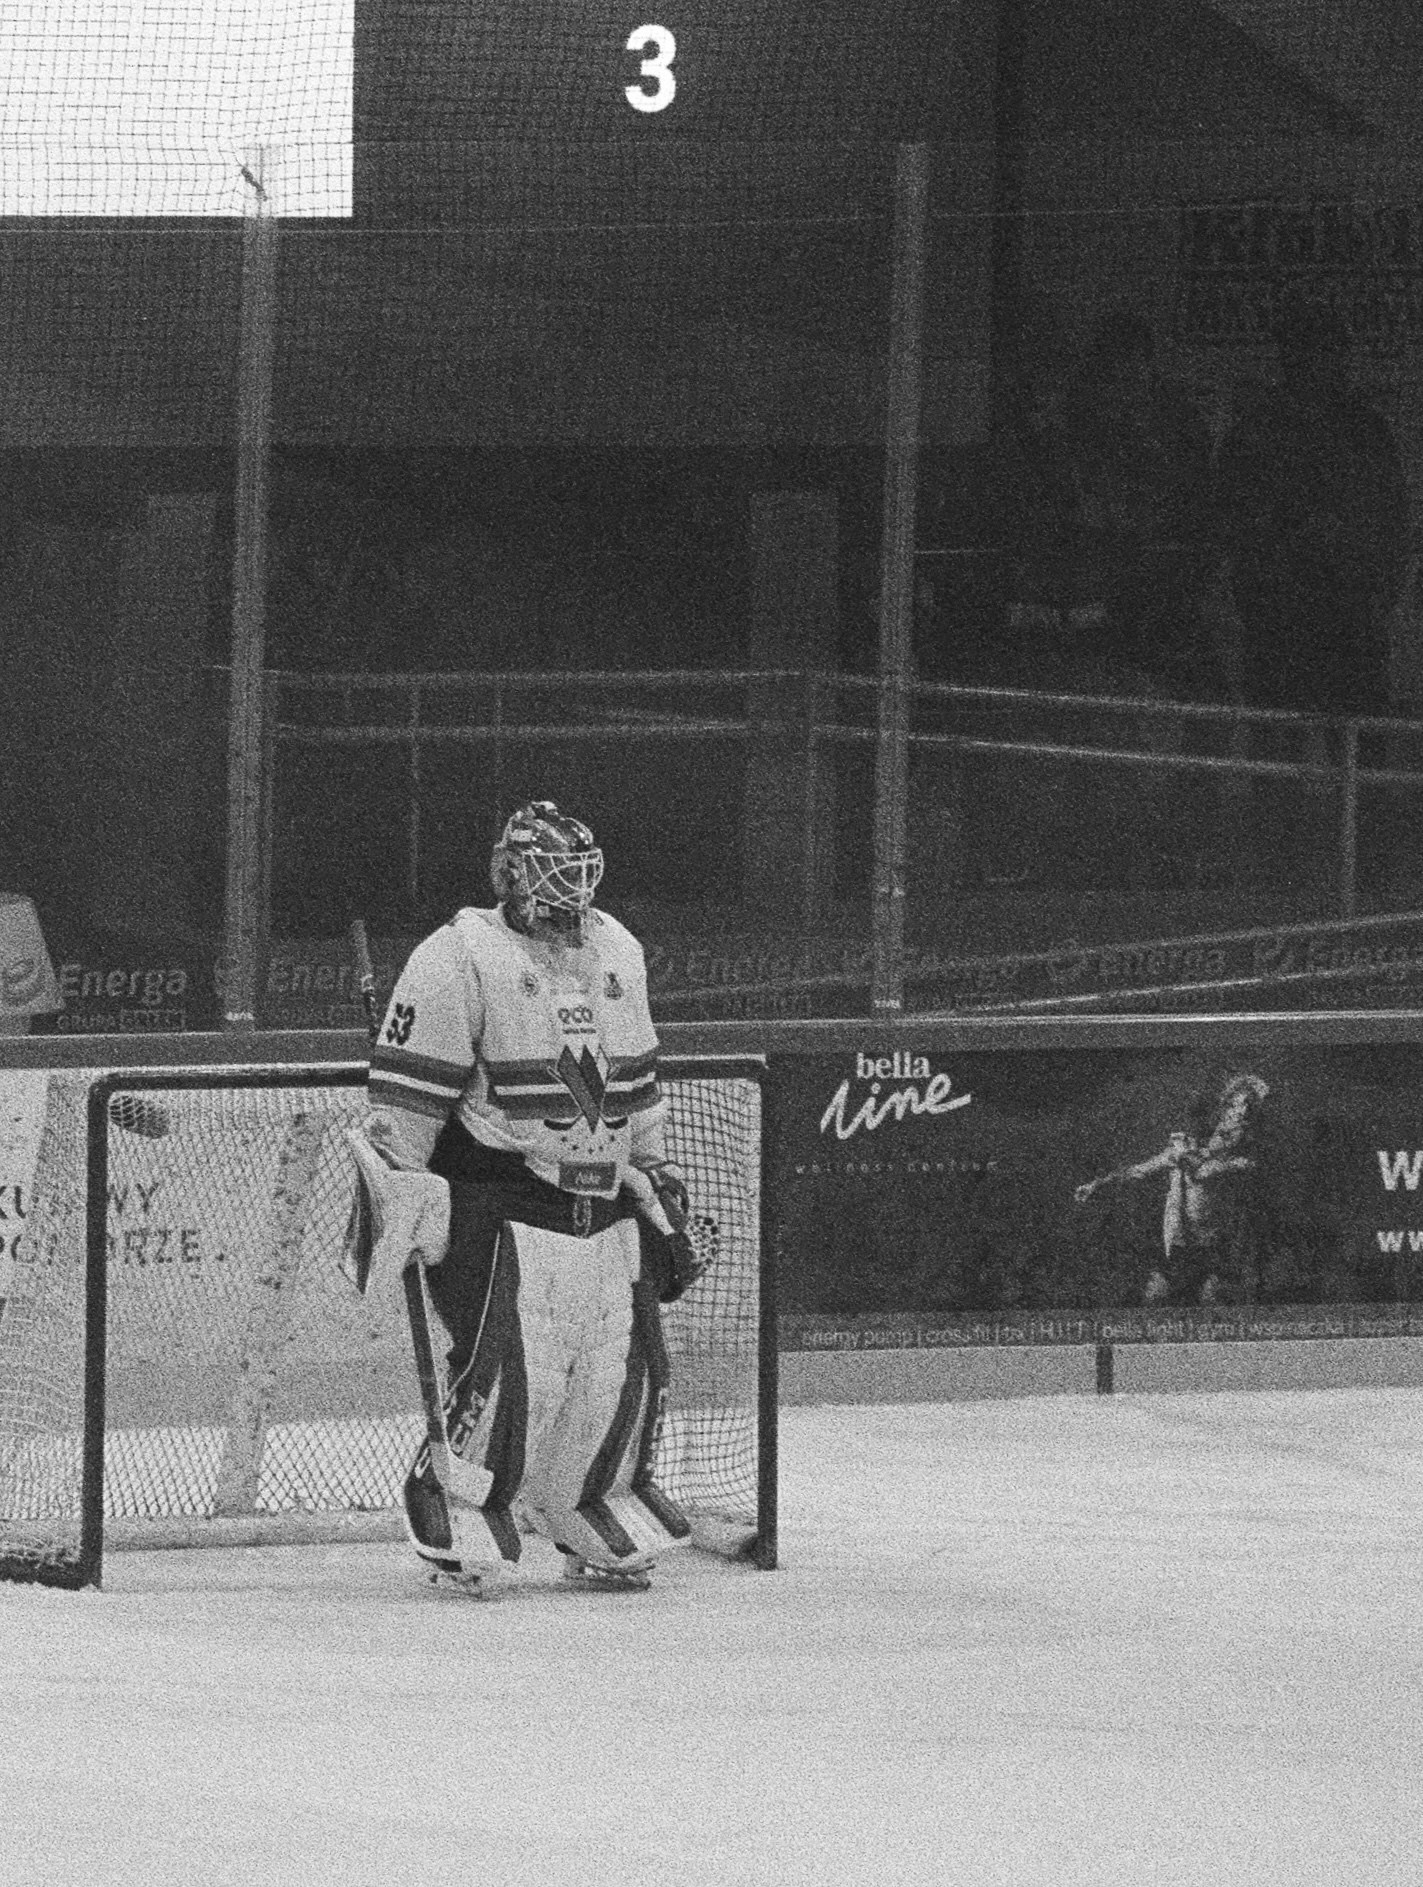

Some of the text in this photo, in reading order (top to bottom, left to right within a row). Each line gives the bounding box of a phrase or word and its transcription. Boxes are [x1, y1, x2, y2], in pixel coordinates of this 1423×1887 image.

[625, 24, 677, 113] 3
[59, 964, 188, 1005] Energa
[856, 1051, 930, 1079] bella
[820, 1073, 973, 1140] line
